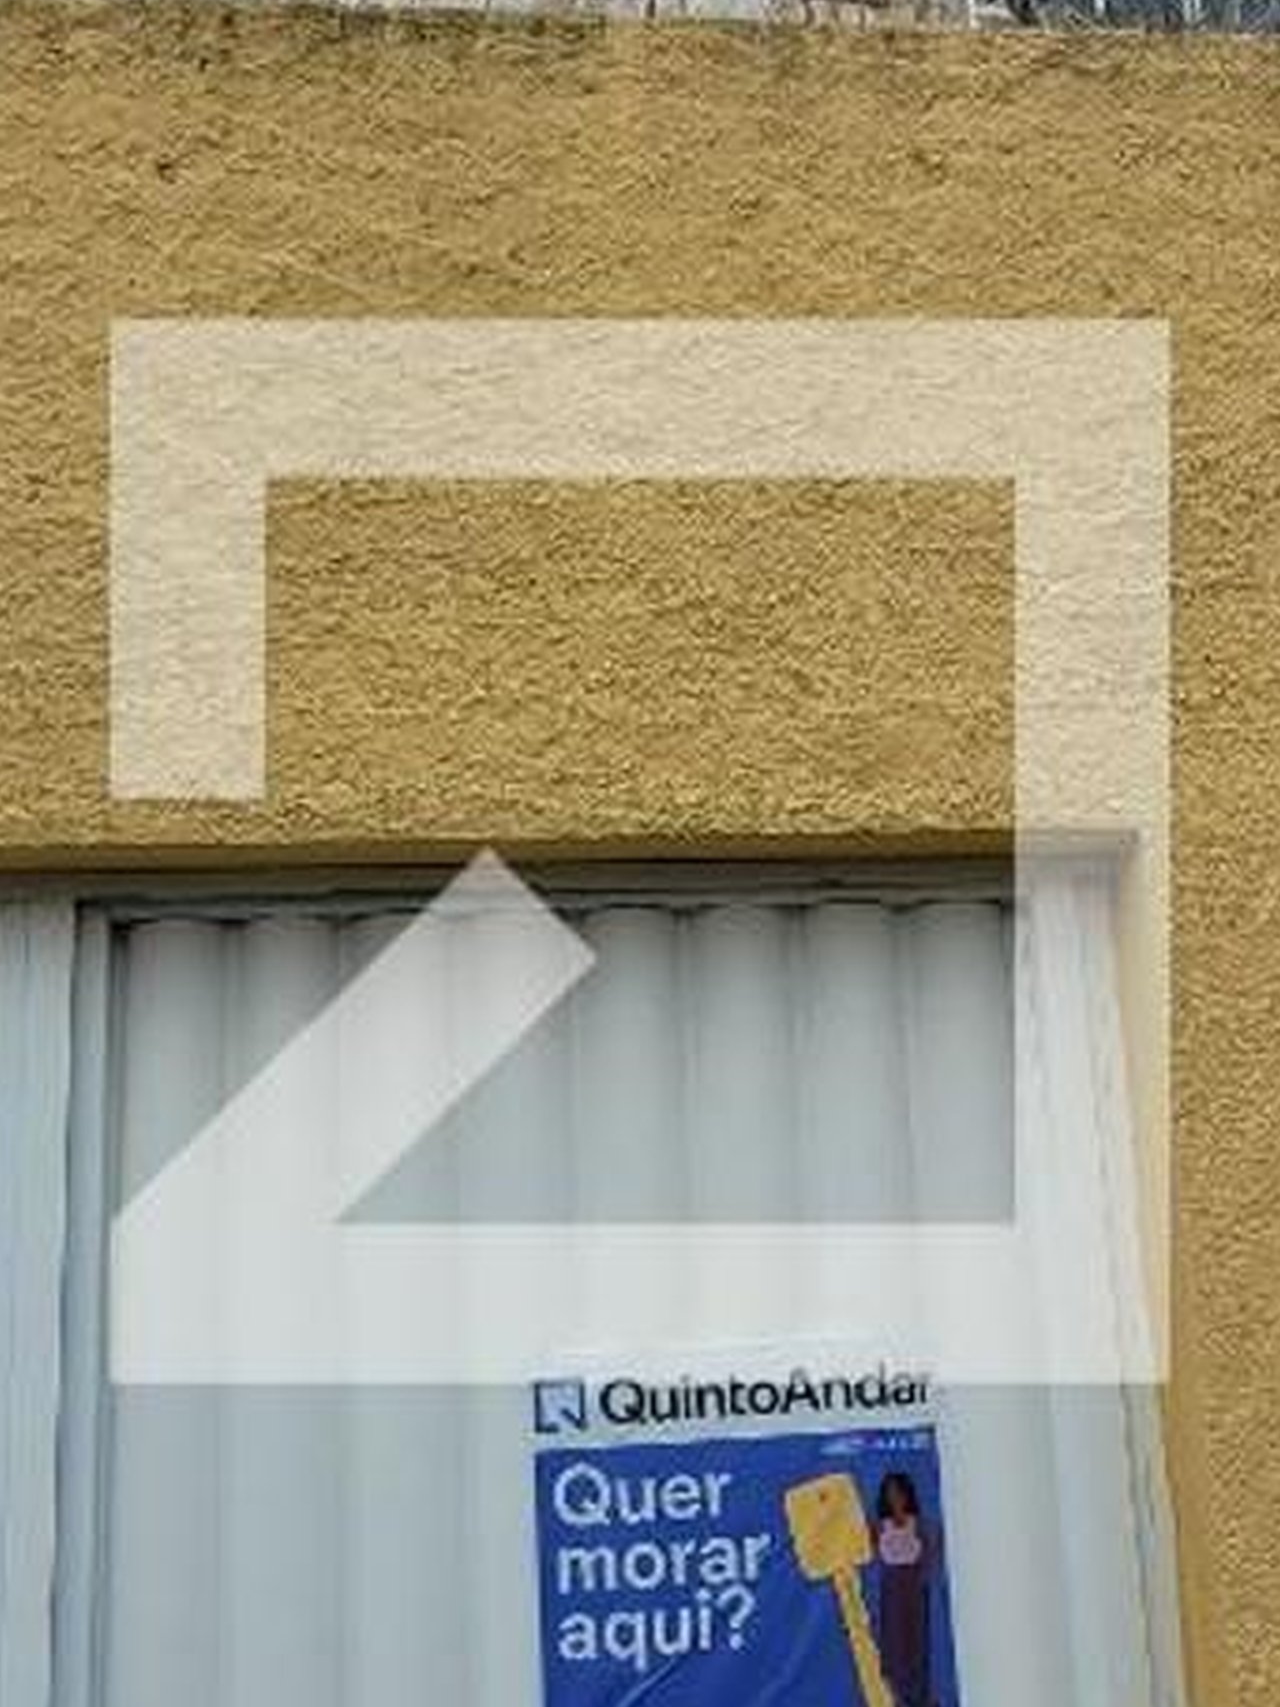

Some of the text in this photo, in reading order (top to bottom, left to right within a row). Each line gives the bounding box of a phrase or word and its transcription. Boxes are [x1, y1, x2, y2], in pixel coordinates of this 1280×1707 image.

[599, 1361, 932, 1426] QuintoAndar
[554, 1462, 732, 1526] Quer
[558, 1533, 771, 1594] morar
[559, 1584, 755, 1671] aqui?
